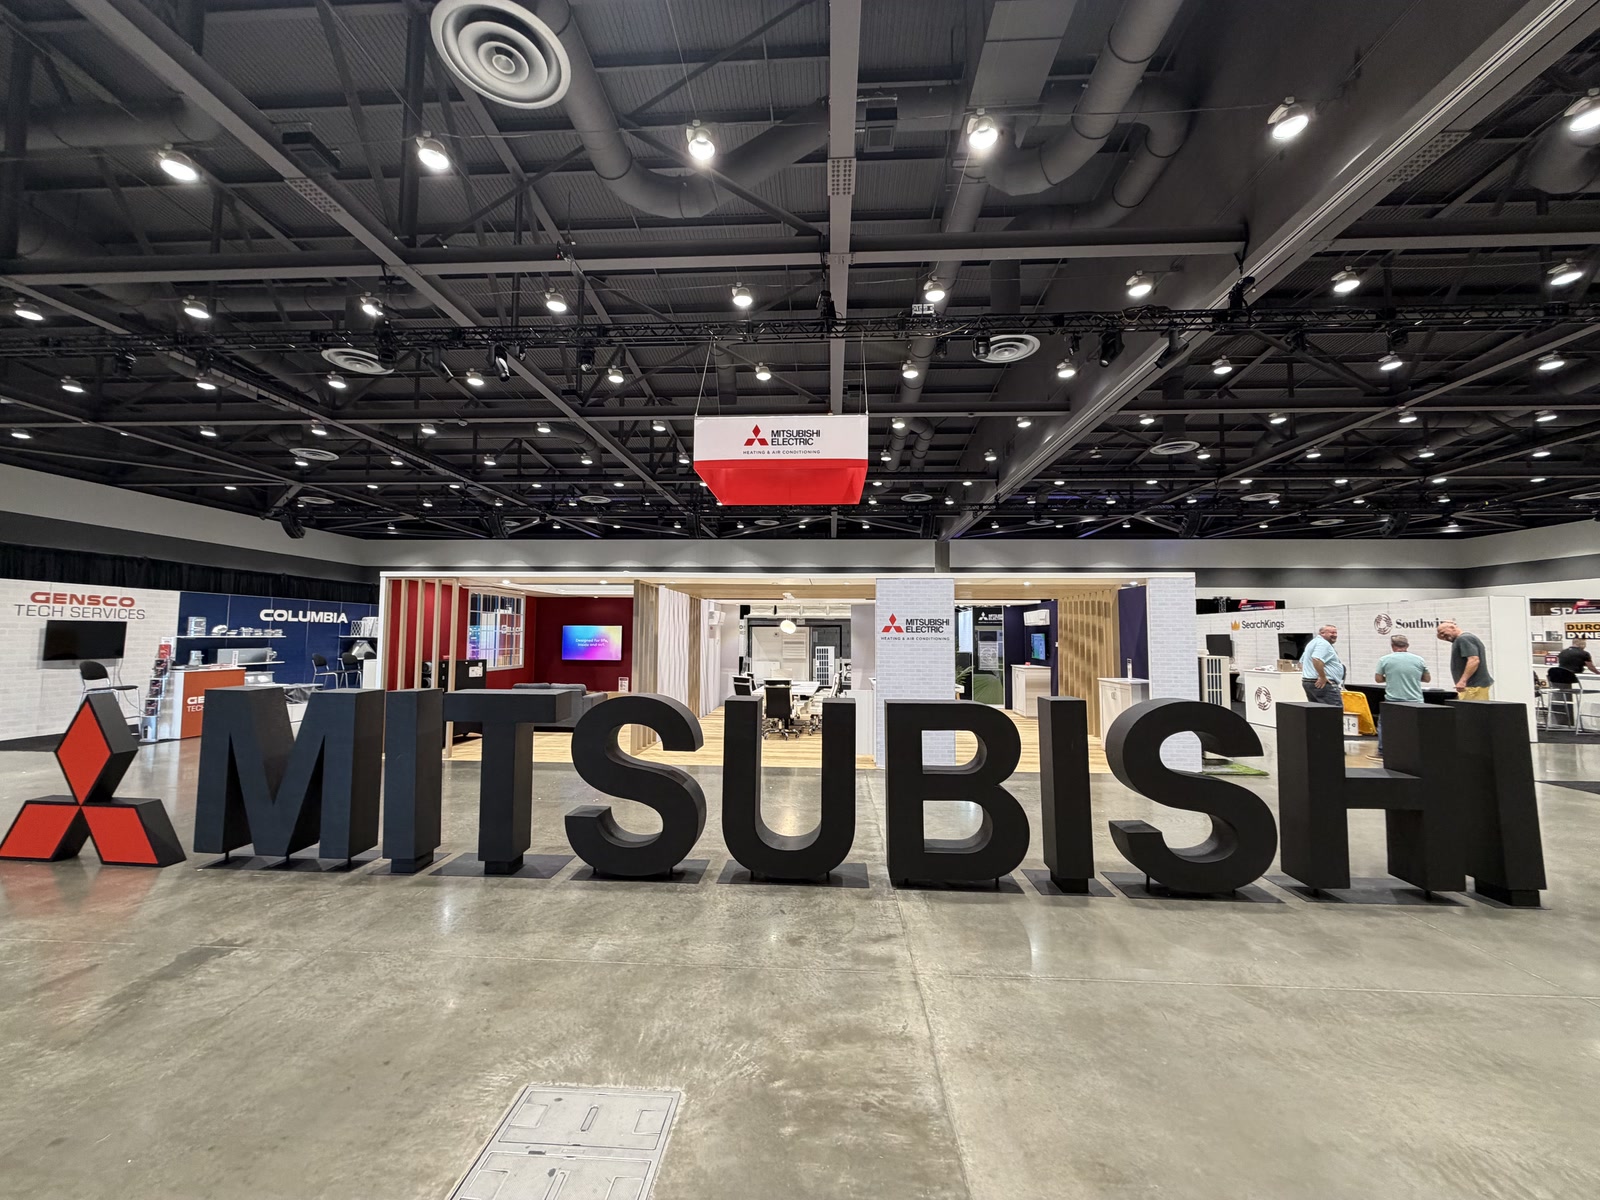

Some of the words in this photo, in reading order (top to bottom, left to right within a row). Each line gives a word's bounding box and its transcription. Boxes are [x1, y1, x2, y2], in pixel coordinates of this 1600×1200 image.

[771, 429, 821, 438] MITSUBISHI
[771, 438, 814, 446] ELECTRIC
[30, 591, 136, 608] GENSCO
[14, 604, 64, 617] TECH
[70, 606, 146, 620] SERVICES
[260, 609, 349, 624] COLUMBIA
[905, 618, 950, 626] MITSUBISHI
[1241, 620, 1285, 631] SearchKings
[193, 684, 1547, 907] MITSUBISHI
